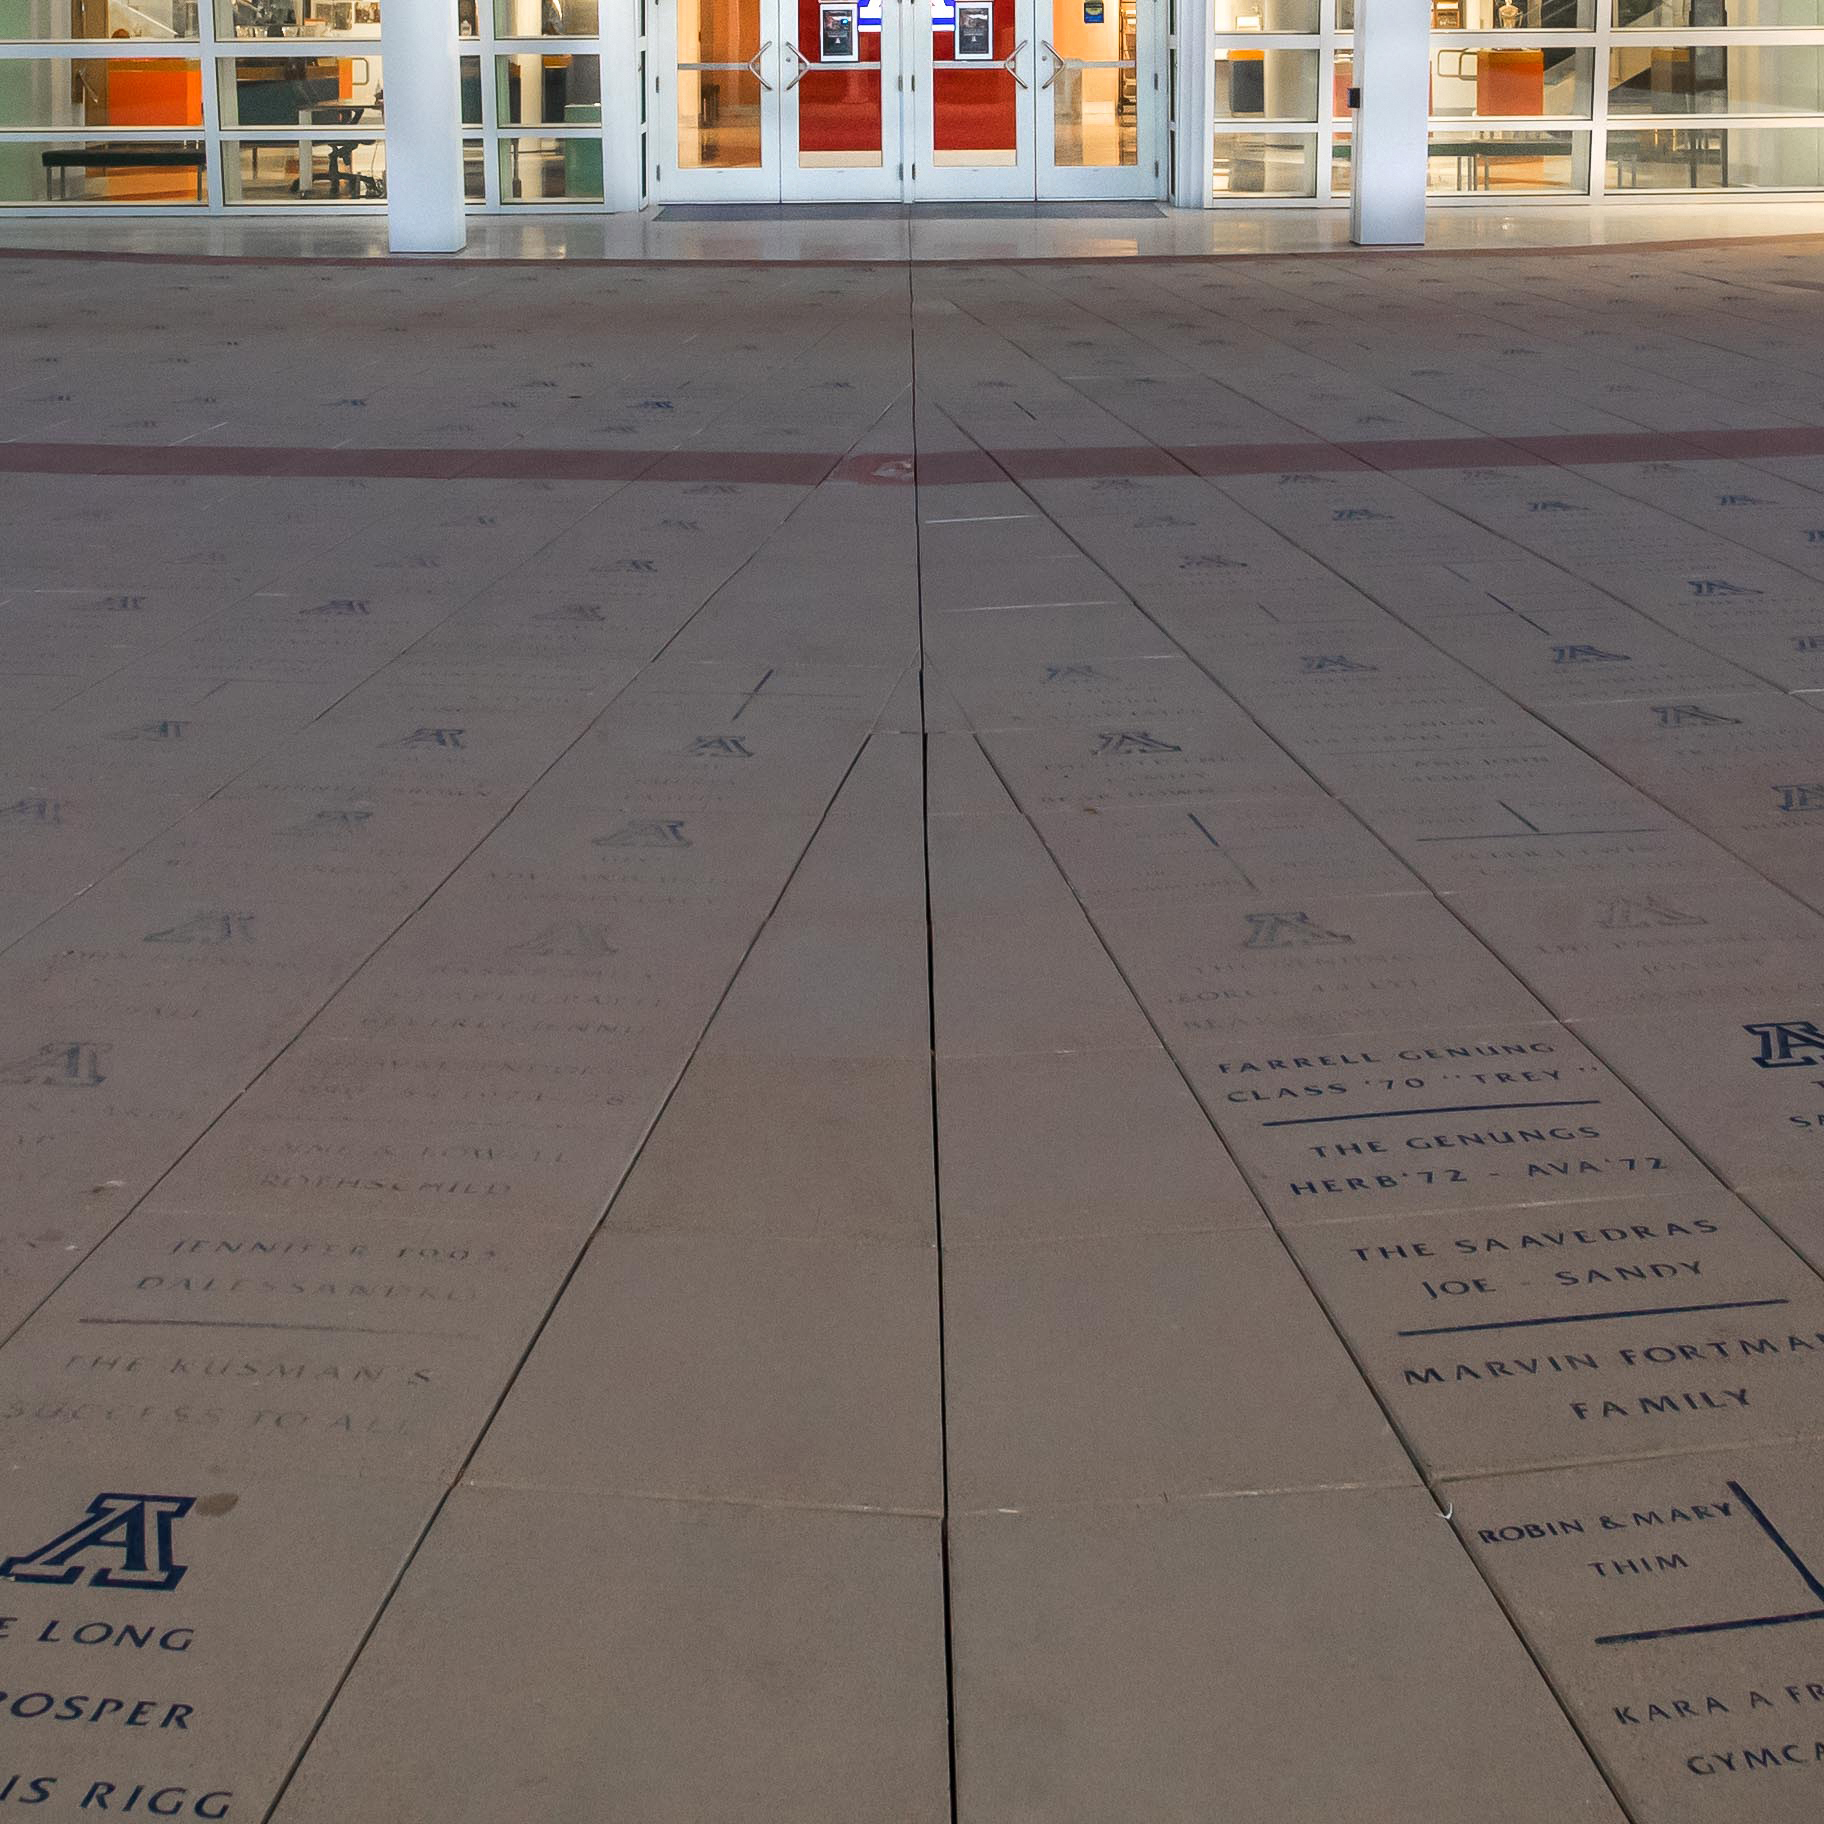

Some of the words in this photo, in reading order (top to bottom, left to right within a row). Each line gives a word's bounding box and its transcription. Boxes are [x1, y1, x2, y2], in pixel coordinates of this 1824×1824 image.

[1216, 1051, 1382, 1075] FARRELL
[1397, 1041, 1556, 1062] GENUNG
[1225, 1082, 1349, 1104] CLASS
[1308, 1139, 1389, 1159] THE
[1404, 1125, 1601, 1152] GENUNGS
[1349, 1241, 1437, 1263] THE
[1453, 1218, 1720, 1255] SAAVEDRAS
[1420, 1277, 1497, 1301] JOE
[1553, 1259, 1703, 1288] SANDY
[1399, 1352, 1600, 1387] MARVIN
[1568, 1386, 1752, 1422] FAMILY
[1475, 1518, 1586, 1546] ROBIN
[1597, 1514, 1628, 1532] &
[1630, 1501, 1734, 1528] MARY
[1586, 1552, 1690, 1579] THIM
[35, 1618, 197, 1658] LONG
[1610, 1694, 1731, 1727] KARA
[1747, 1688, 1775, 1710] A
[78, 1780, 235, 1824] RIGG
